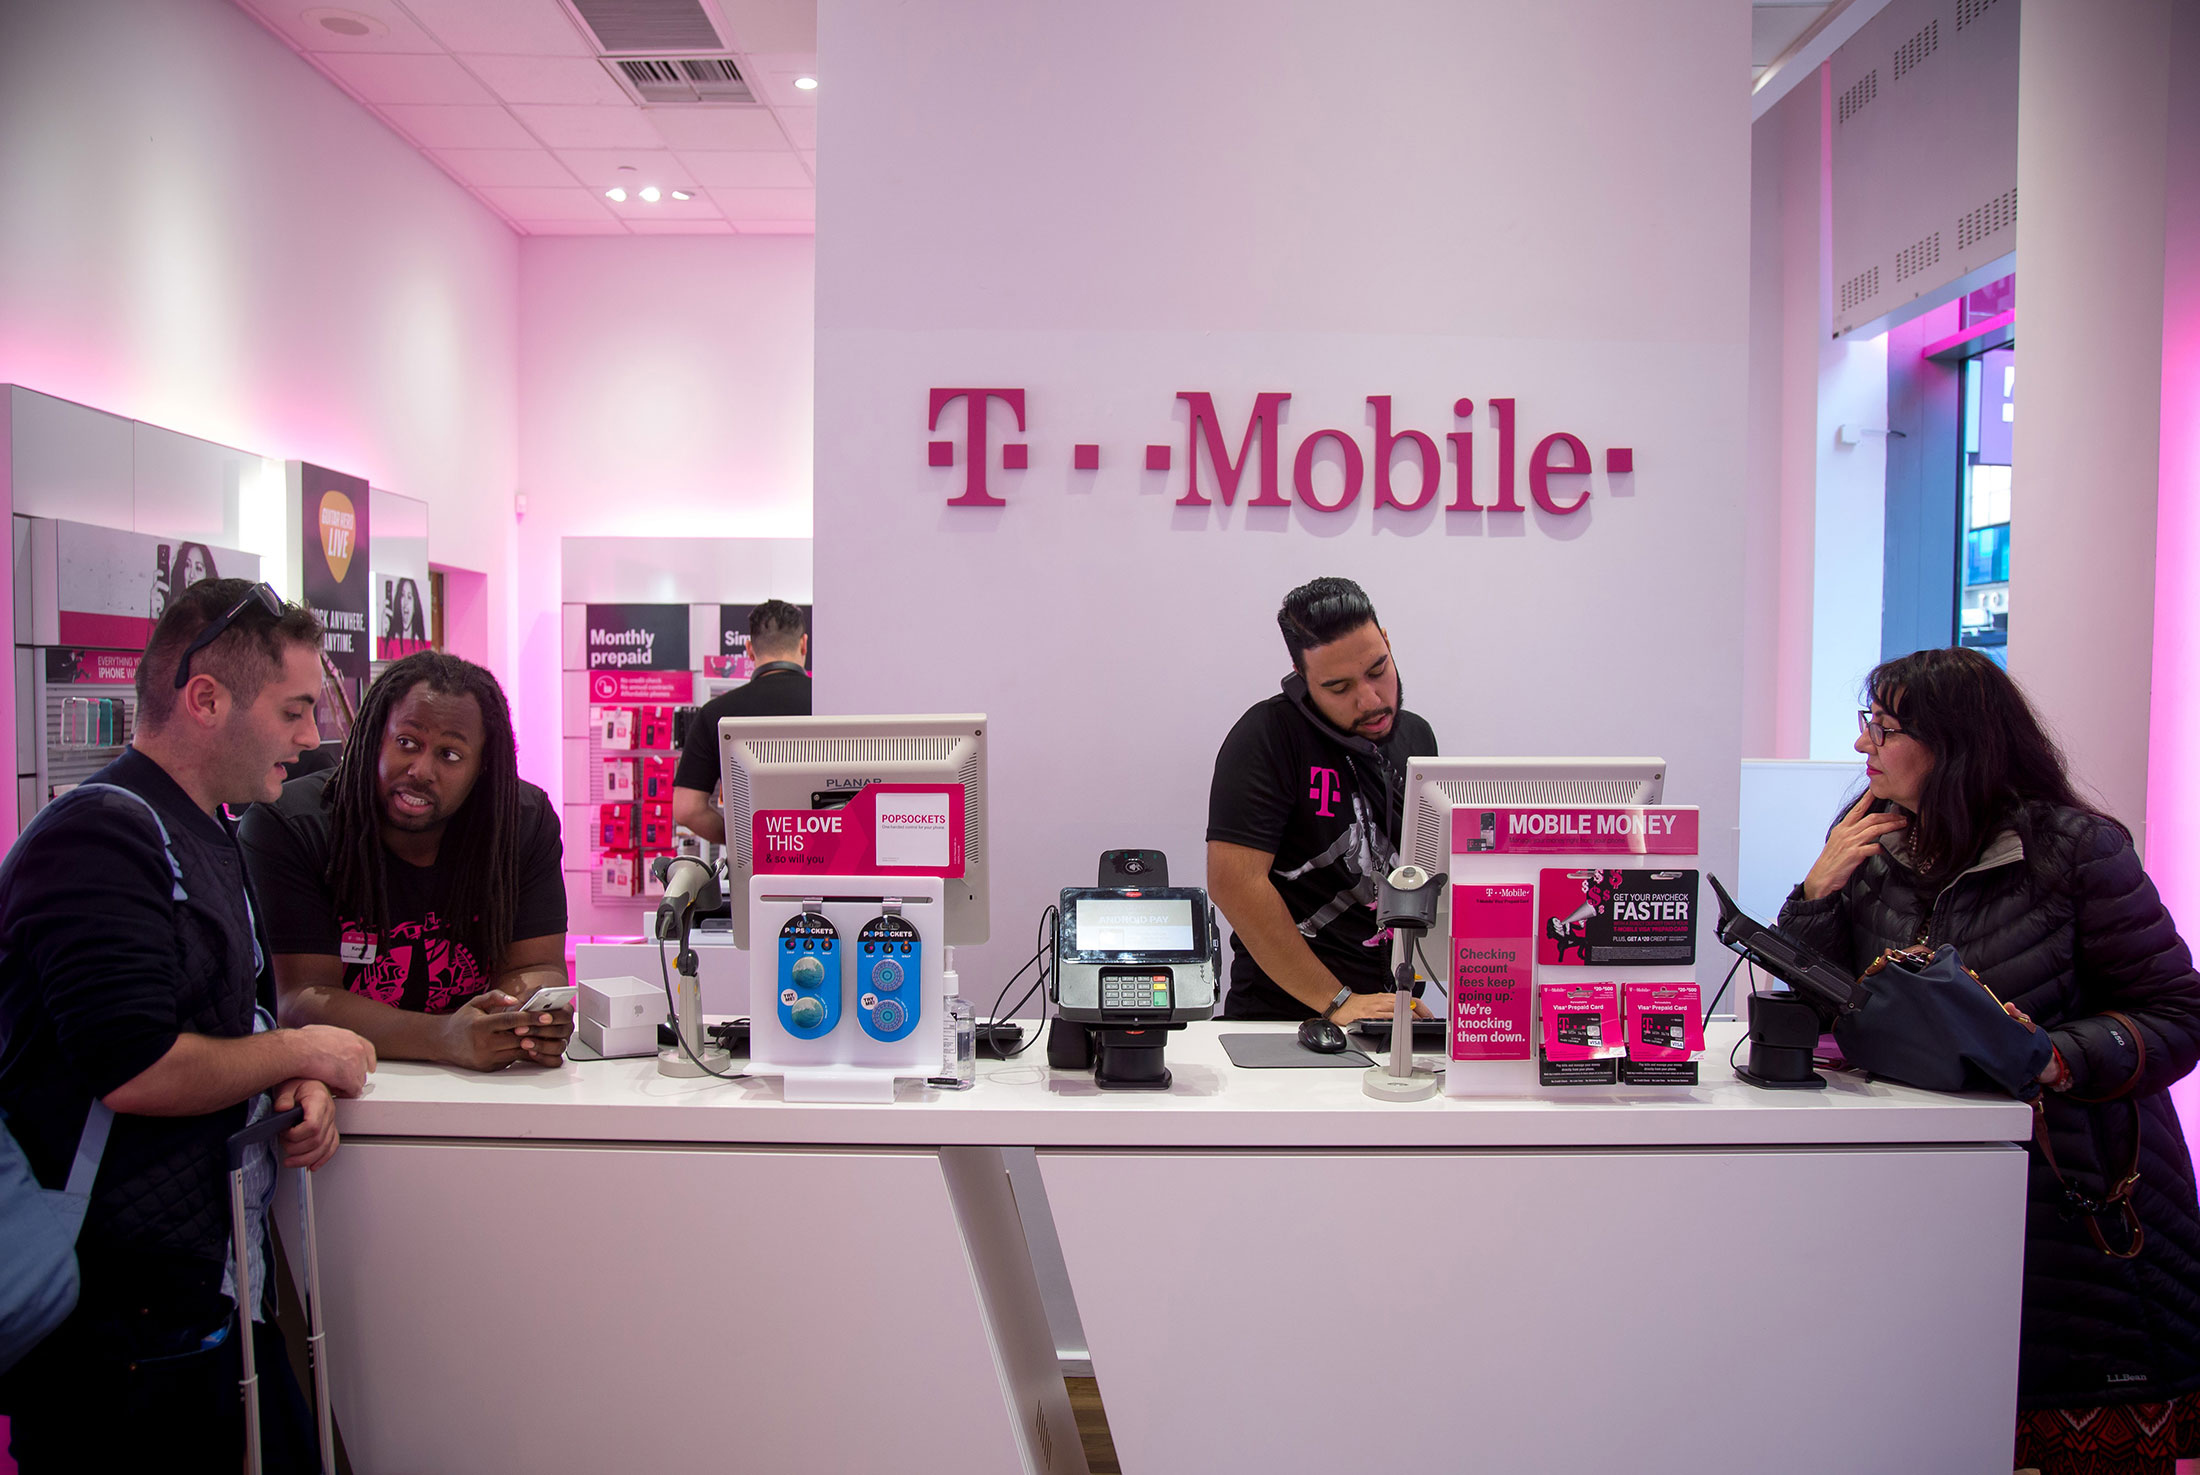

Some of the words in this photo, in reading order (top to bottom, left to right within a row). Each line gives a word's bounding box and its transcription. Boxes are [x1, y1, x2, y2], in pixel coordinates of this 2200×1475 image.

[328, 528, 349, 558] LIVE
[330, 611, 366, 632] ANYWHERE.
[324, 633, 354, 653] ANYTIME.
[590, 629, 655, 649] Monthly
[724, 630, 751, 646] Sim
[97, 656, 133, 667] EVERYTHING
[591, 648, 652, 668] prepaid
[126, 668, 136, 679] WA
[766, 817, 792, 833] WE
[797, 817, 842, 833] LOVE
[881, 814, 946, 824] POPSOCKETS
[1509, 814, 1592, 835] MOBILE
[1596, 815, 1677, 835] MONEY
[766, 835, 805, 851] THIS
[766, 854, 773, 864] &
[775, 856, 786, 864] so
[788, 853, 805, 864] will
[807, 856, 825, 866] you
[1613, 893, 1629, 901] GET
[1630, 893, 1651, 901] YOUR
[1652, 893, 1689, 901] PAYCHECK
[1613, 901, 1689, 920] FASTER
[1098, 915, 1148, 924] ANDROID
[1150, 915, 1169, 924] PAY
[785, 927, 834, 935] POPSOCKETS
[863, 930, 913, 938] POPSOCKETS
[1460, 948, 1516, 961] Checking
[1459, 964, 1508, 973] account
[1459, 975, 1484, 987] fees
[1487, 976, 1515, 989] keep
[1459, 990, 1492, 1004] going
[1652, 1004, 1673, 1012] Prepaid
[1458, 1017, 1513, 1031] knocking
[1457, 1031, 1488, 1042] them
[1490, 1031, 1526, 1042] down.
